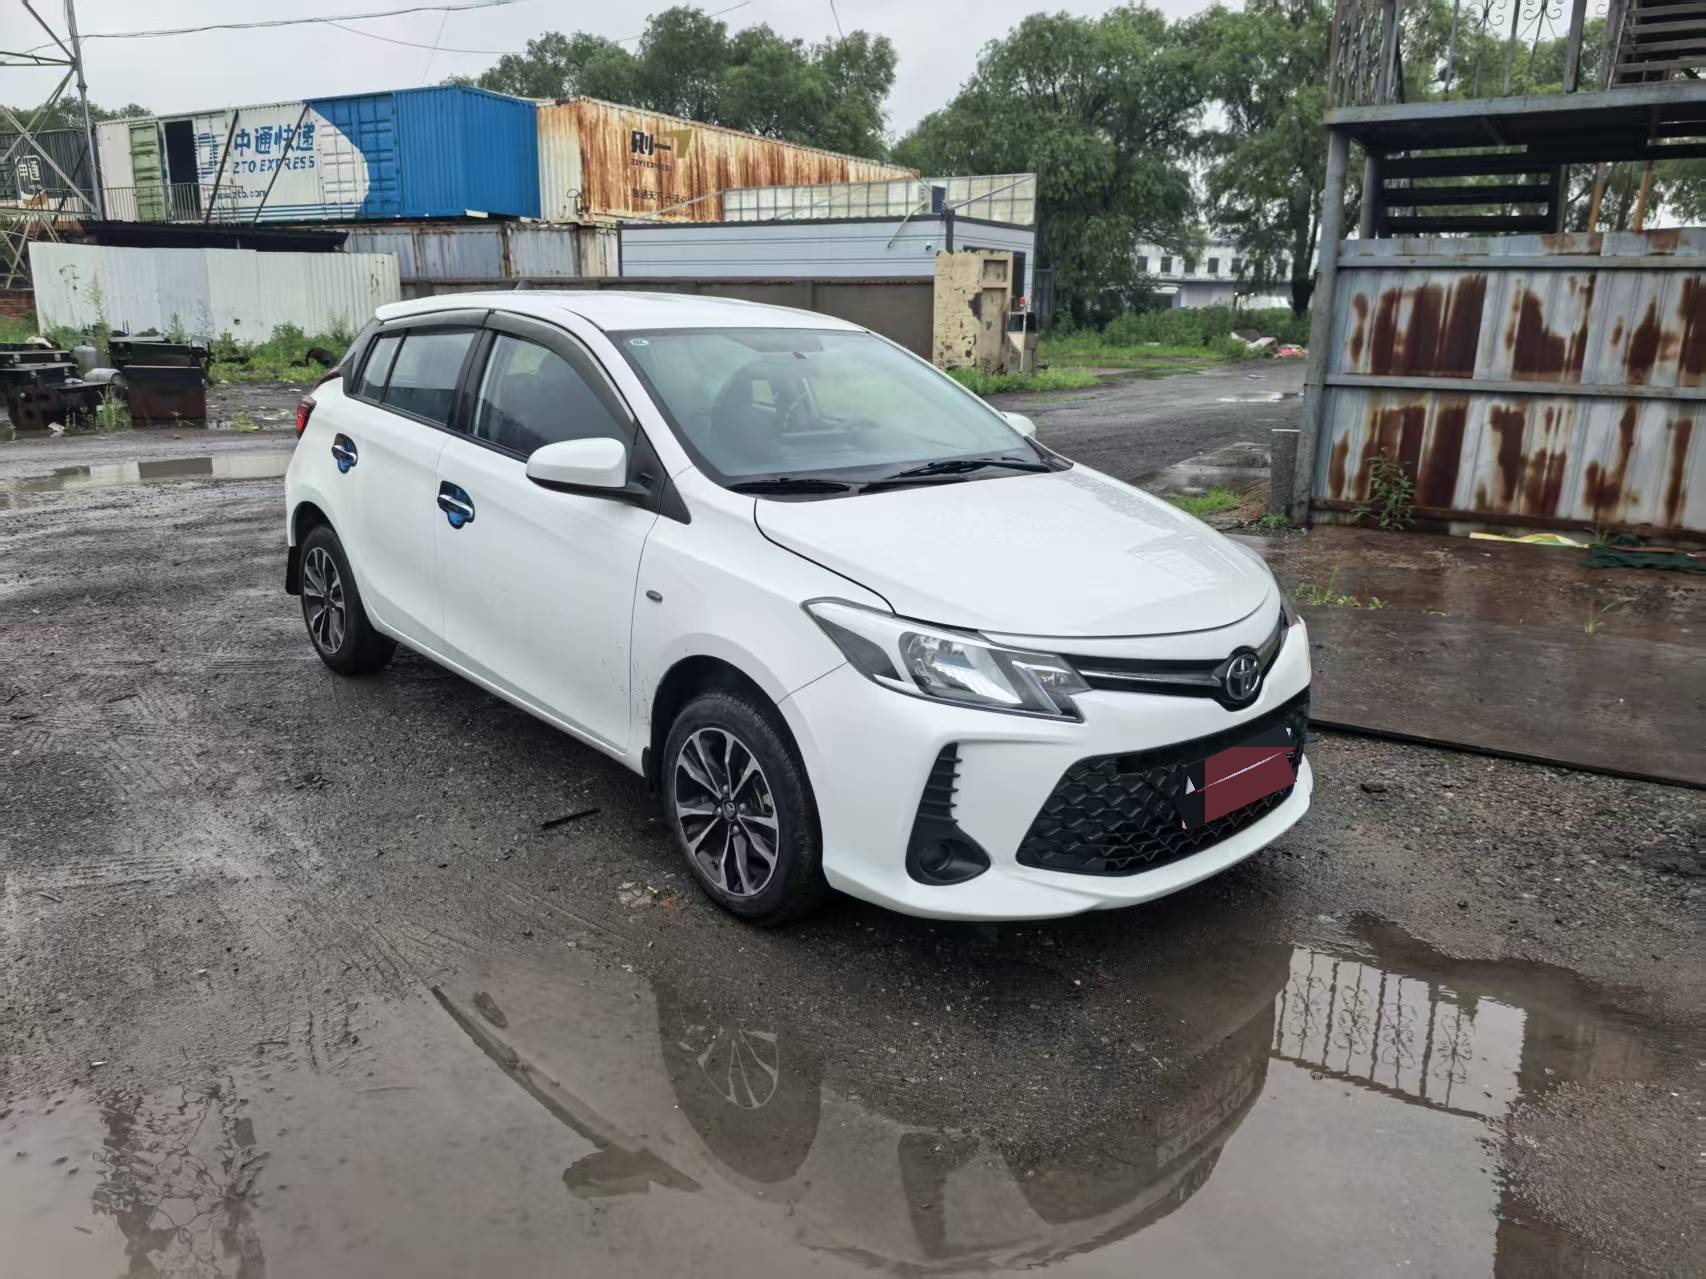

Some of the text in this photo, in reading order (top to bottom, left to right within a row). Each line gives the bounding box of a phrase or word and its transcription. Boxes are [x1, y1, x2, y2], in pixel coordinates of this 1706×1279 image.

[234, 122, 315, 156] 中通快递
[233, 156, 315, 174] ZTO EXPRESS
